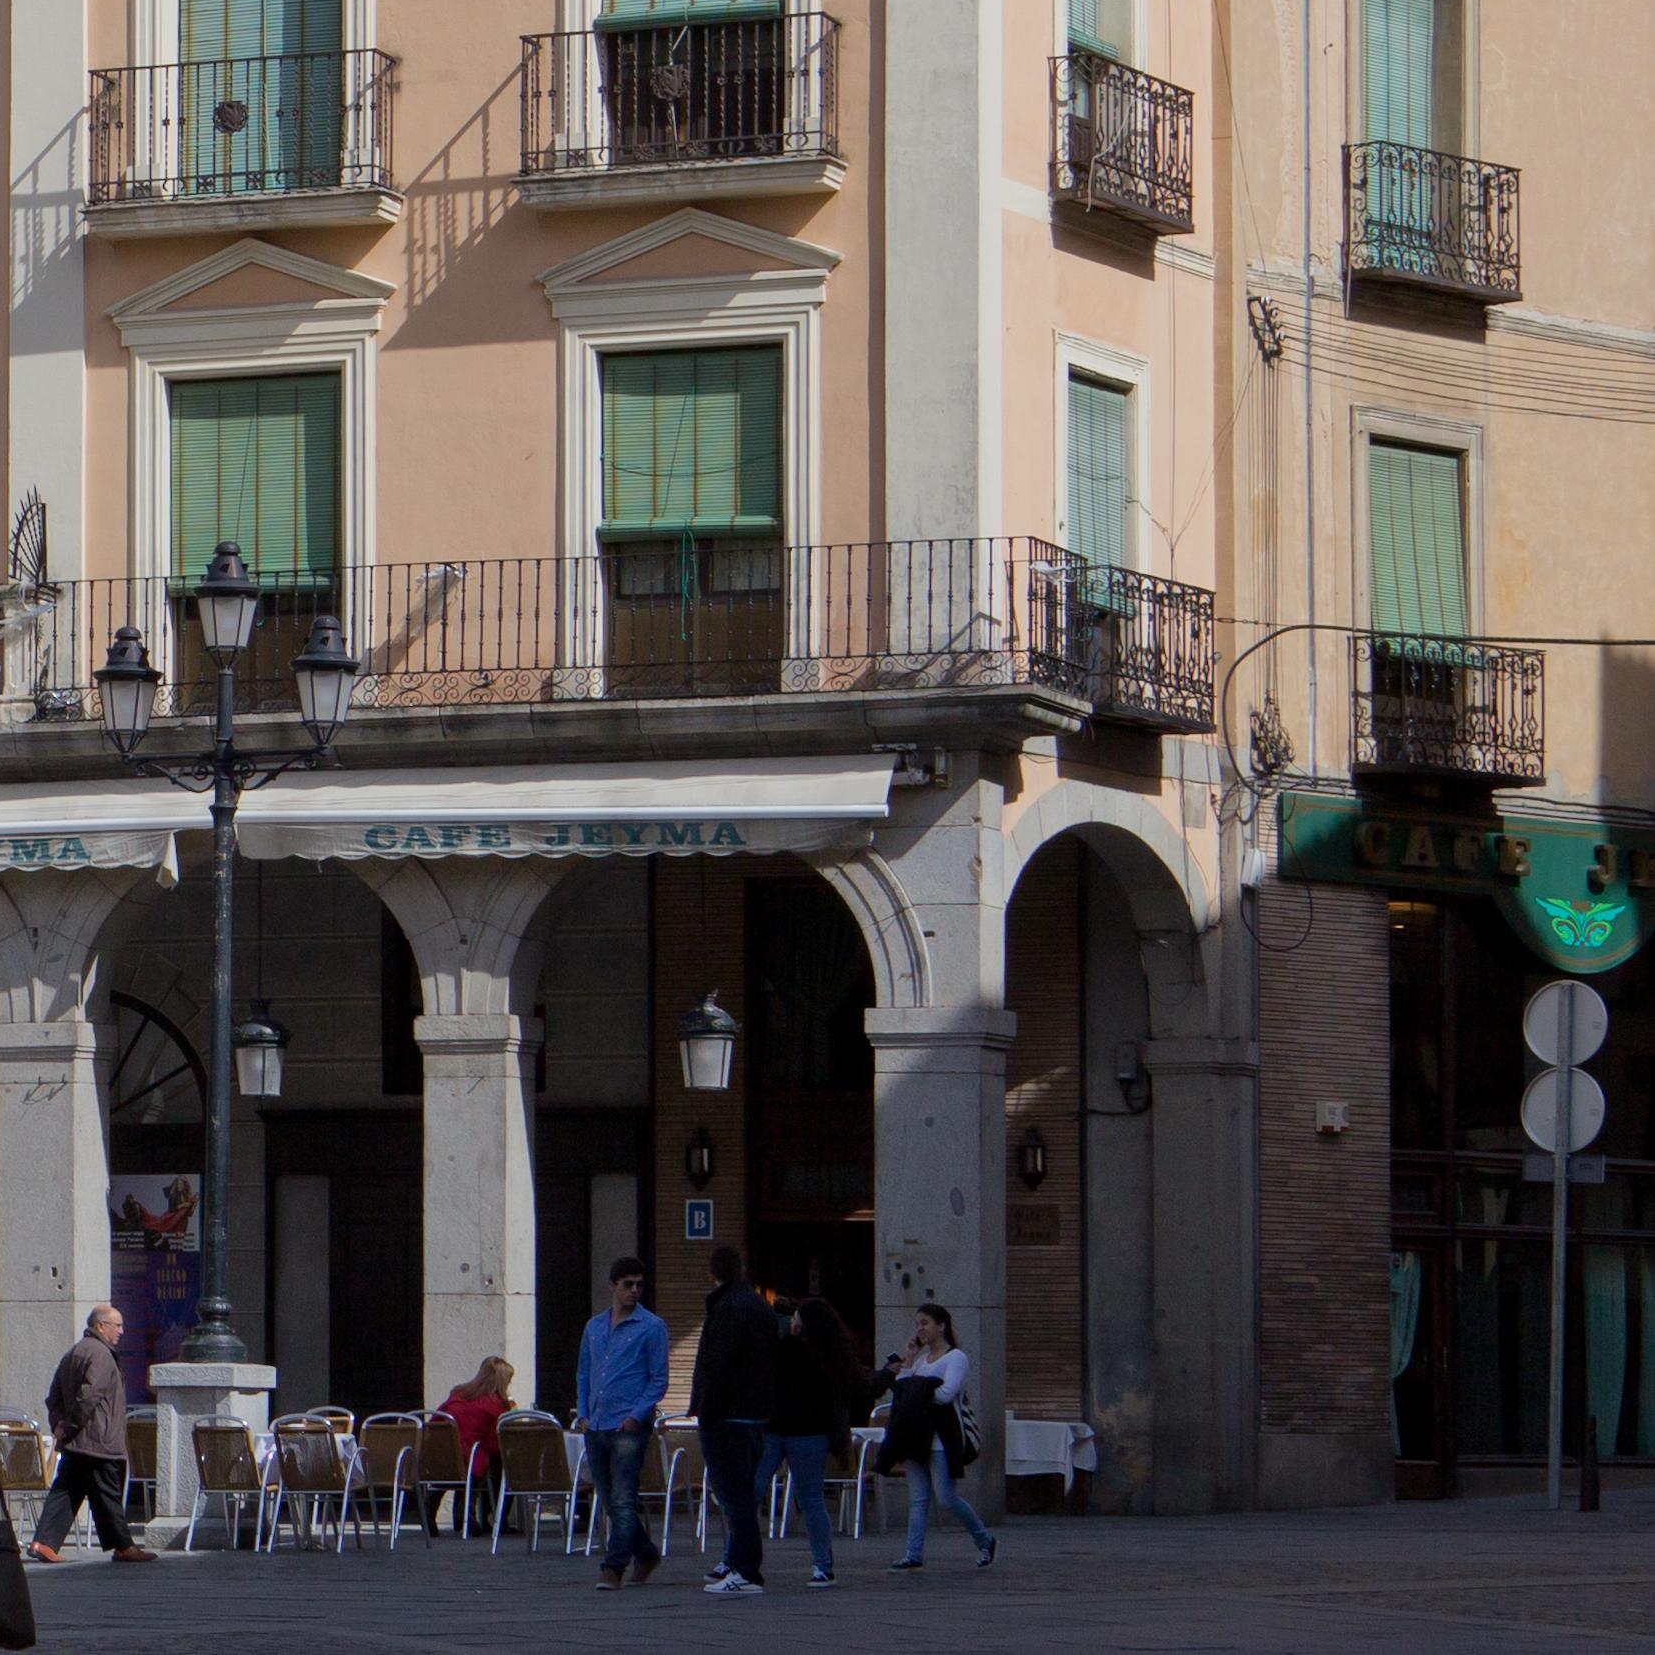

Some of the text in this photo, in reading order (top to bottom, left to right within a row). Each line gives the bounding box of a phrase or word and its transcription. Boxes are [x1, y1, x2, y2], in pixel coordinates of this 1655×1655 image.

[362, 821, 747, 850] CAFE JEYMA
[1353, 819, 1532, 877] CAFE
[693, 1209, 707, 1230] B
